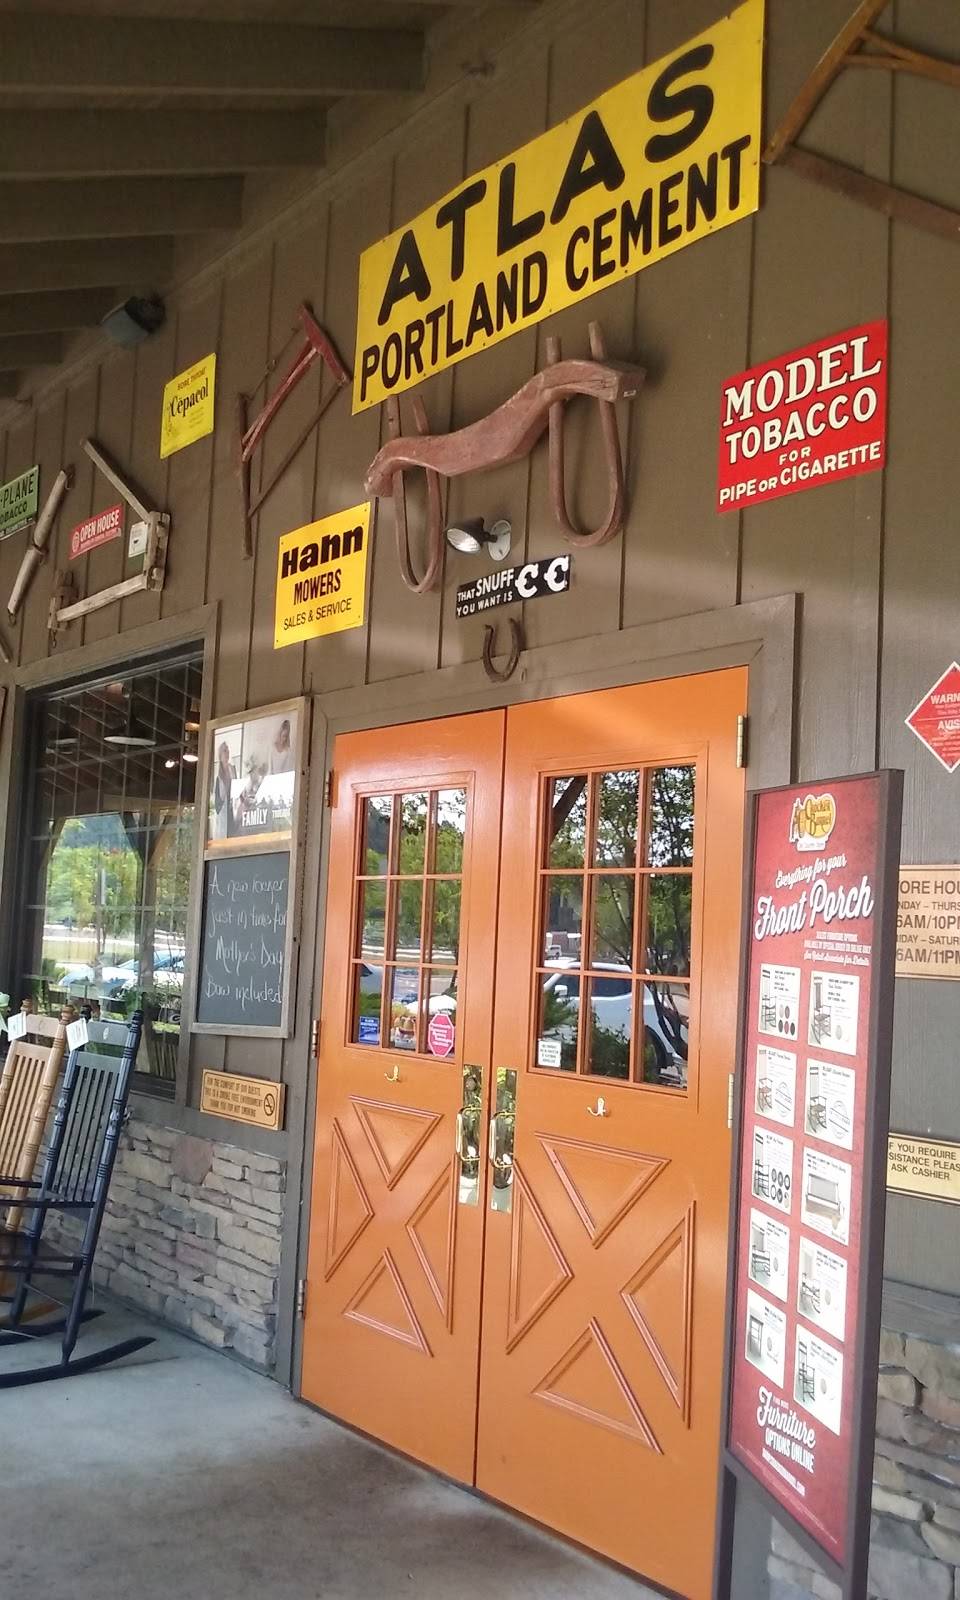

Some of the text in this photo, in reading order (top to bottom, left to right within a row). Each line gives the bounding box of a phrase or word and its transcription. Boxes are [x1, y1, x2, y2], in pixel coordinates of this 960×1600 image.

[377, 43, 715, 326] ATLAS
[360, 134, 752, 402] PORTLAND CEMENT
[722, 336, 882, 427] MODEL
[725, 387, 877, 464] TOBACCO
[719, 441, 881, 505] PIPE OR CIGARETTE
[778, 446, 811, 466] FOR
[80, 520, 97, 542] OPEN
[97, 509, 120, 534] HOUSE
[281, 525, 364, 579] Hann
[293, 568, 342, 606] MOWERS
[456, 590, 513, 617] YOU WANT IS
[457, 588, 475, 603] THAT
[475, 568, 515, 597] SNUFF
[283, 598, 352, 631] SALES & SERVICE
[242, 807, 268, 827] FAMILY
[775, 853, 848, 890] Everything for your
[900, 880, 931, 895] ORE
[208, 905, 233, 938] just
[754, 875, 875, 941] Front Porch
[896, 934, 919, 944] IDAY
[259, 932, 283, 984] Day
[888, 1152, 930, 1167] SISTANCE
[897, 1143, 915, 1154] YOU
[918, 1146, 957, 1160] REQUIRE
[891, 1163, 950, 1181] ASK CASHIER
[757, 1385, 816, 1449] Furniture
[764, 1427, 791, 1458] OPTIONS
[790, 1441, 815, 1474] ONLINE
